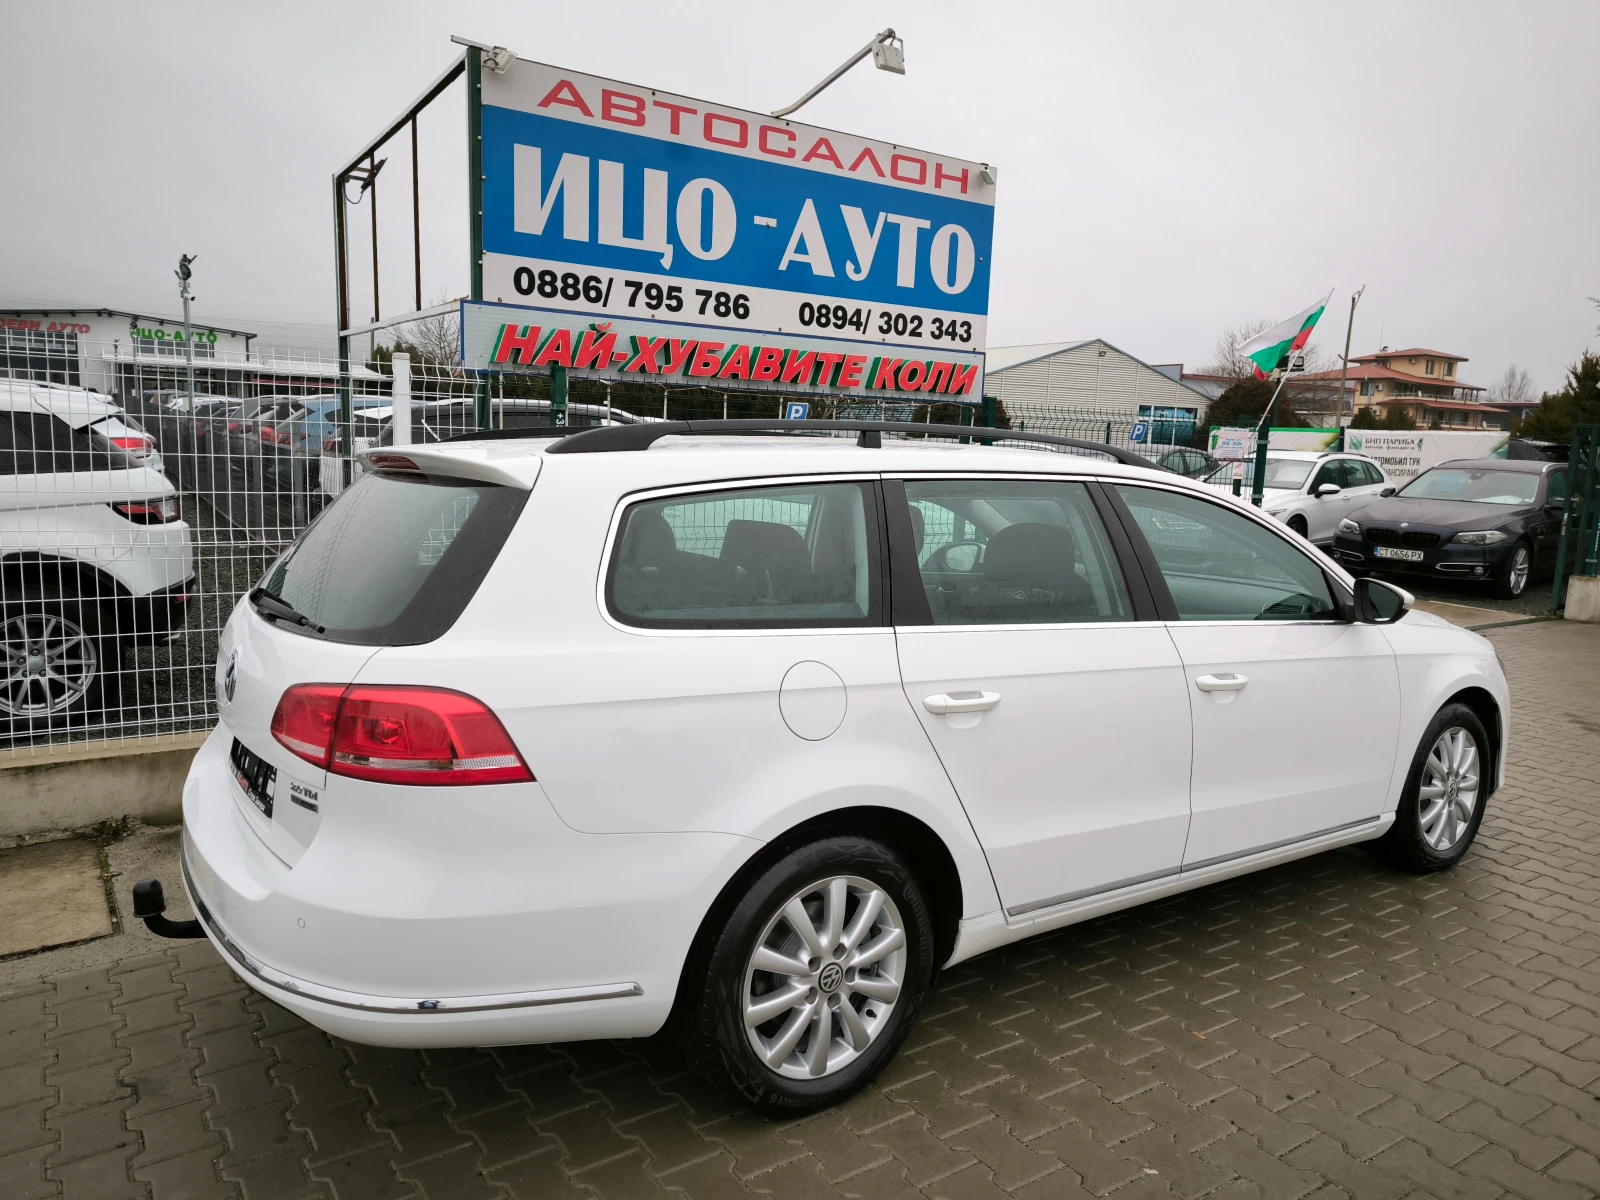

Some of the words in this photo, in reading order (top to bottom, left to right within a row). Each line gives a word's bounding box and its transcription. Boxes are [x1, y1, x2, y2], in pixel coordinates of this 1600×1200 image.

[538, 80, 970, 195] АВТОСАЛОН
[513, 266, 614, 308] 0886/
[624, 280, 684, 313] 795
[695, 288, 750, 320] 786
[798, 301, 872, 335] 0894/
[878, 311, 923, 338] 302
[930, 317, 972, 343] 343
[489, 322, 868, 388] НАЙ-ХУБАВИТЕ
[870, 356, 978, 395] КОЛИ
[790, 405, 803, 419] P
[1132, 424, 1144, 439] P
[1383, 438, 1415, 446] ПАРИБА
[1390, 549, 1410, 559] 0656
